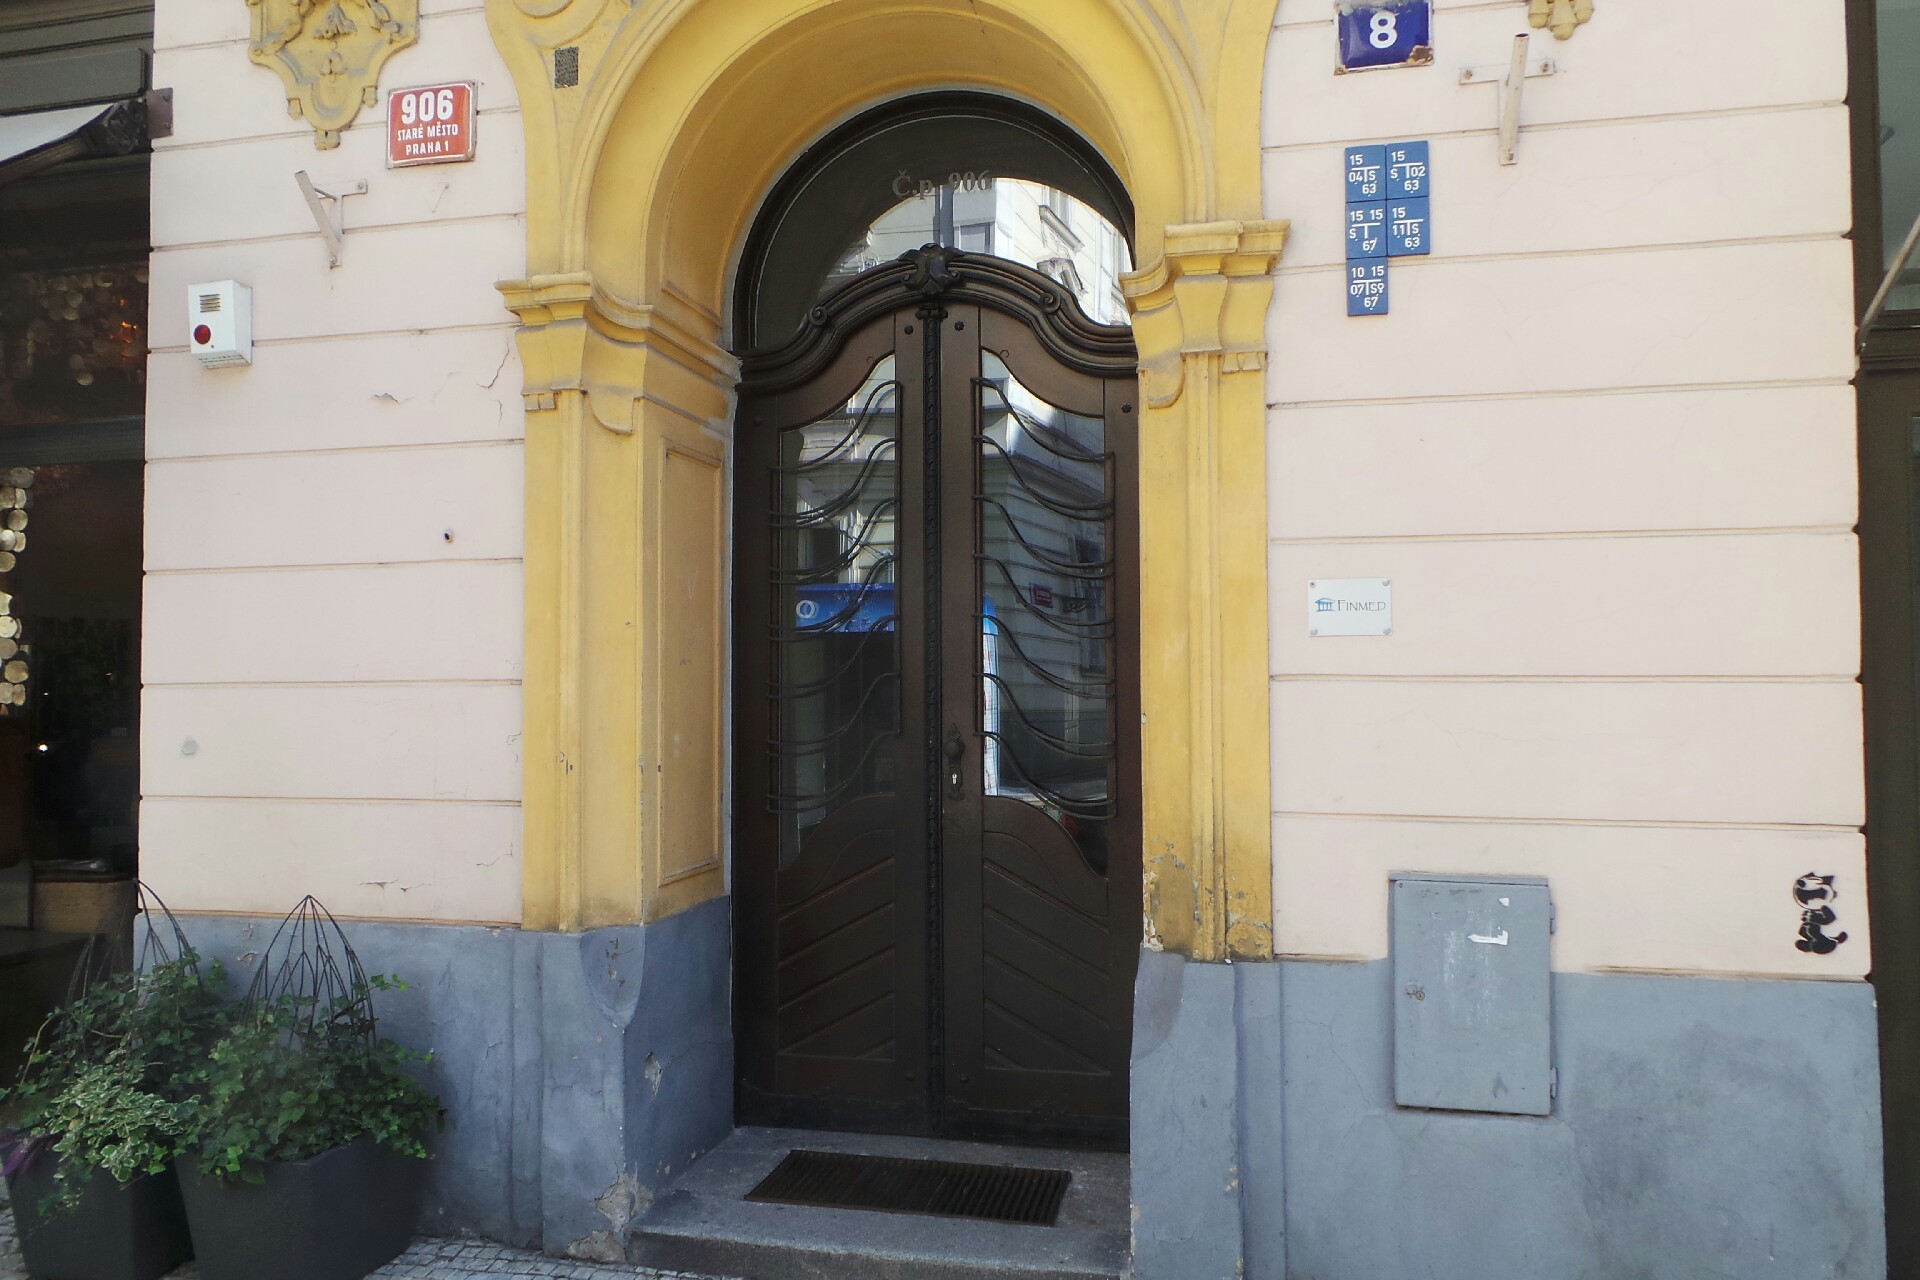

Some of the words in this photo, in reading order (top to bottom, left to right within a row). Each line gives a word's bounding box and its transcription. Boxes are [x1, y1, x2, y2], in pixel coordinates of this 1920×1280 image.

[1369, 9, 1397, 49] 8
[401, 89, 453, 124] 906
[427, 121, 458, 137] MĚSTO
[406, 141, 441, 155] PRAHA
[444, 140, 449, 151] 1
[1349, 154, 1363, 166] 15
[1391, 150, 1405, 162] 15
[948, 170, 992, 191] 906
[1350, 210, 1364, 222] 15
[1369, 208, 1384, 221] 15
[1392, 207, 1406, 219] 15
[1351, 267, 1365, 279] 10
[1371, 265, 1384, 277] 15
